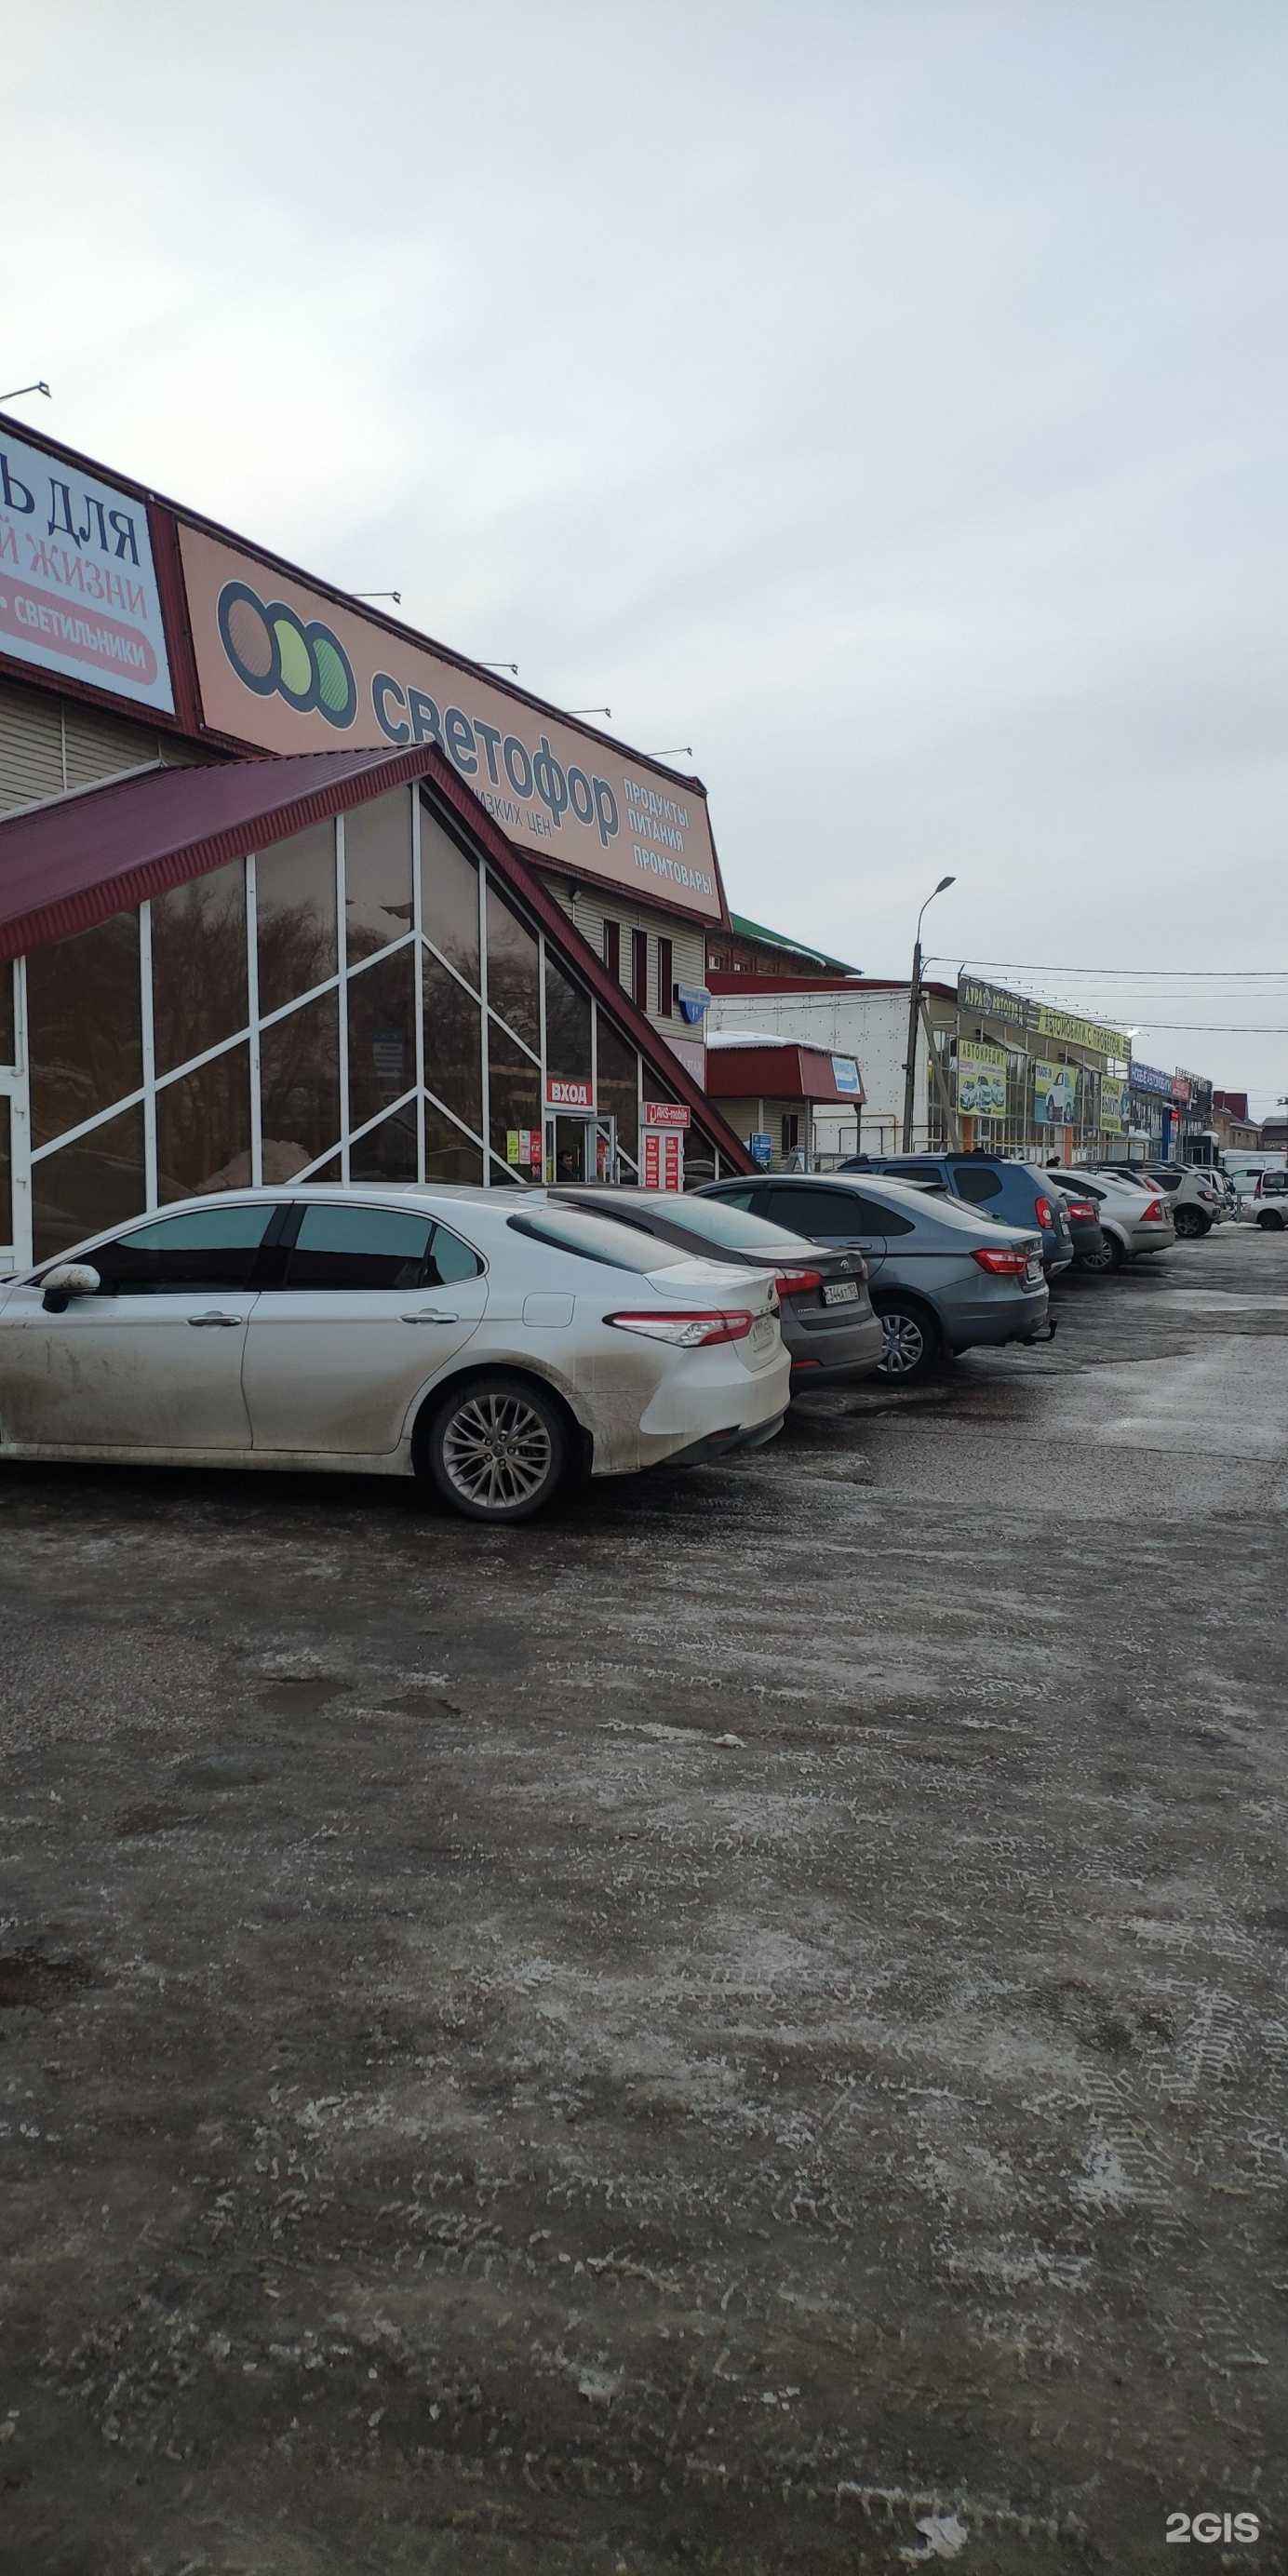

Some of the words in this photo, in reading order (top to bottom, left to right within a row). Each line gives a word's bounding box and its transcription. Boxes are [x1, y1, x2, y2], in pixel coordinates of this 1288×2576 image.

[47, 476, 141, 567] ДЛЯ
[26, 532, 148, 620] ЖИЗНИ
[14, 596, 148, 669] СВЕТИЛЬНИКИ
[526, 811, 552, 840] ЦЕН
[624, 777, 690, 828] ПРОДУКТЫ
[627, 808, 684, 852] ПИТАНИЯ
[633, 844, 714, 895] ПРОМТОВАРЫ
[552, 1082, 587, 1104] ВХОД
